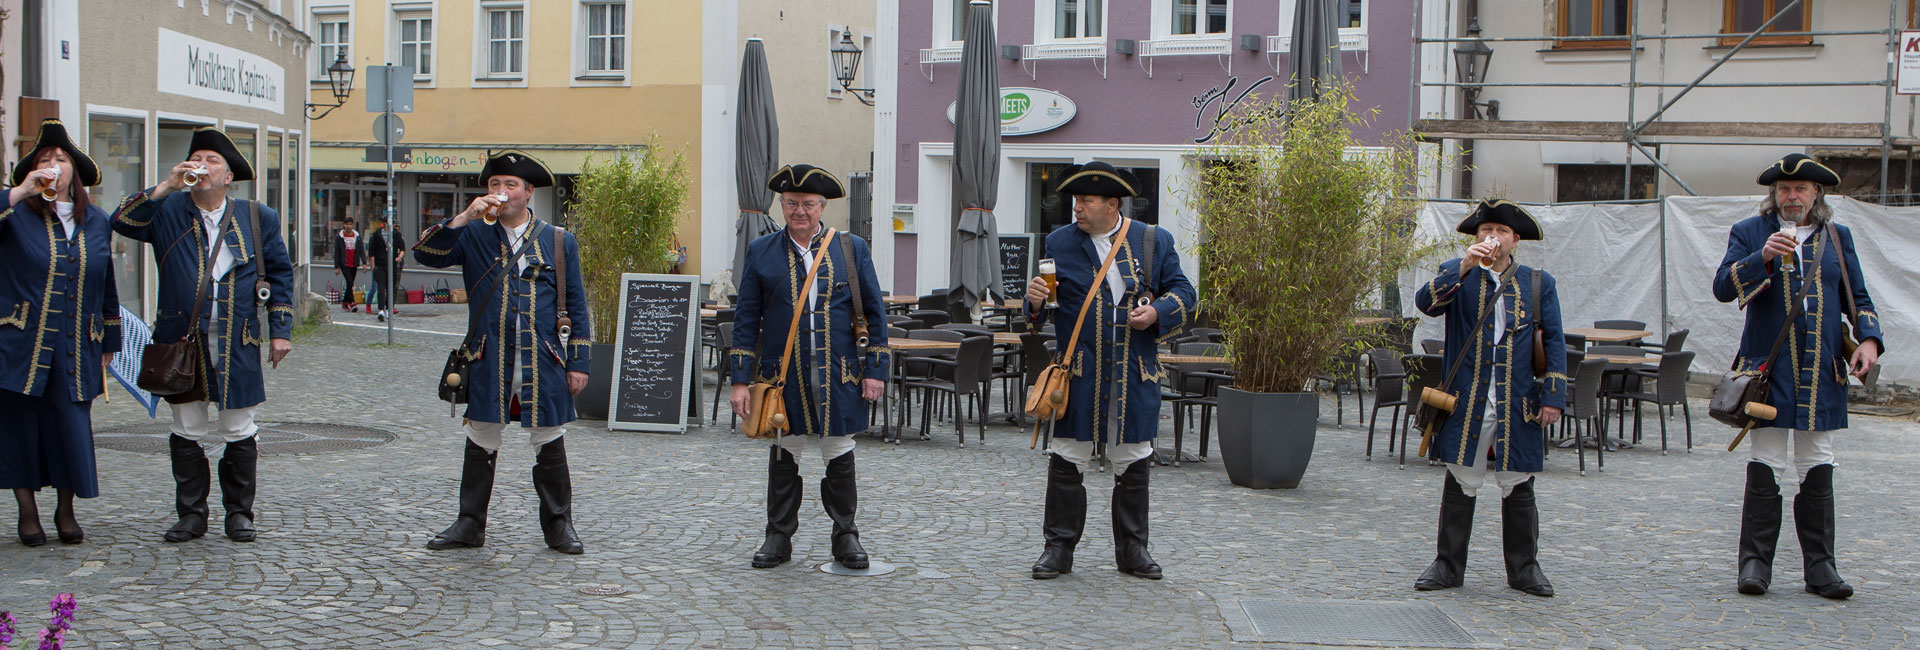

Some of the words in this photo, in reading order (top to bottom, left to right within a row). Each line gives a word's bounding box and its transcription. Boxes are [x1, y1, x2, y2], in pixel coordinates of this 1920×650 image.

[187, 44, 235, 93] Musikhaus
[238, 59, 265, 103] Kapitza
[1001, 97, 1027, 114] MEETS
